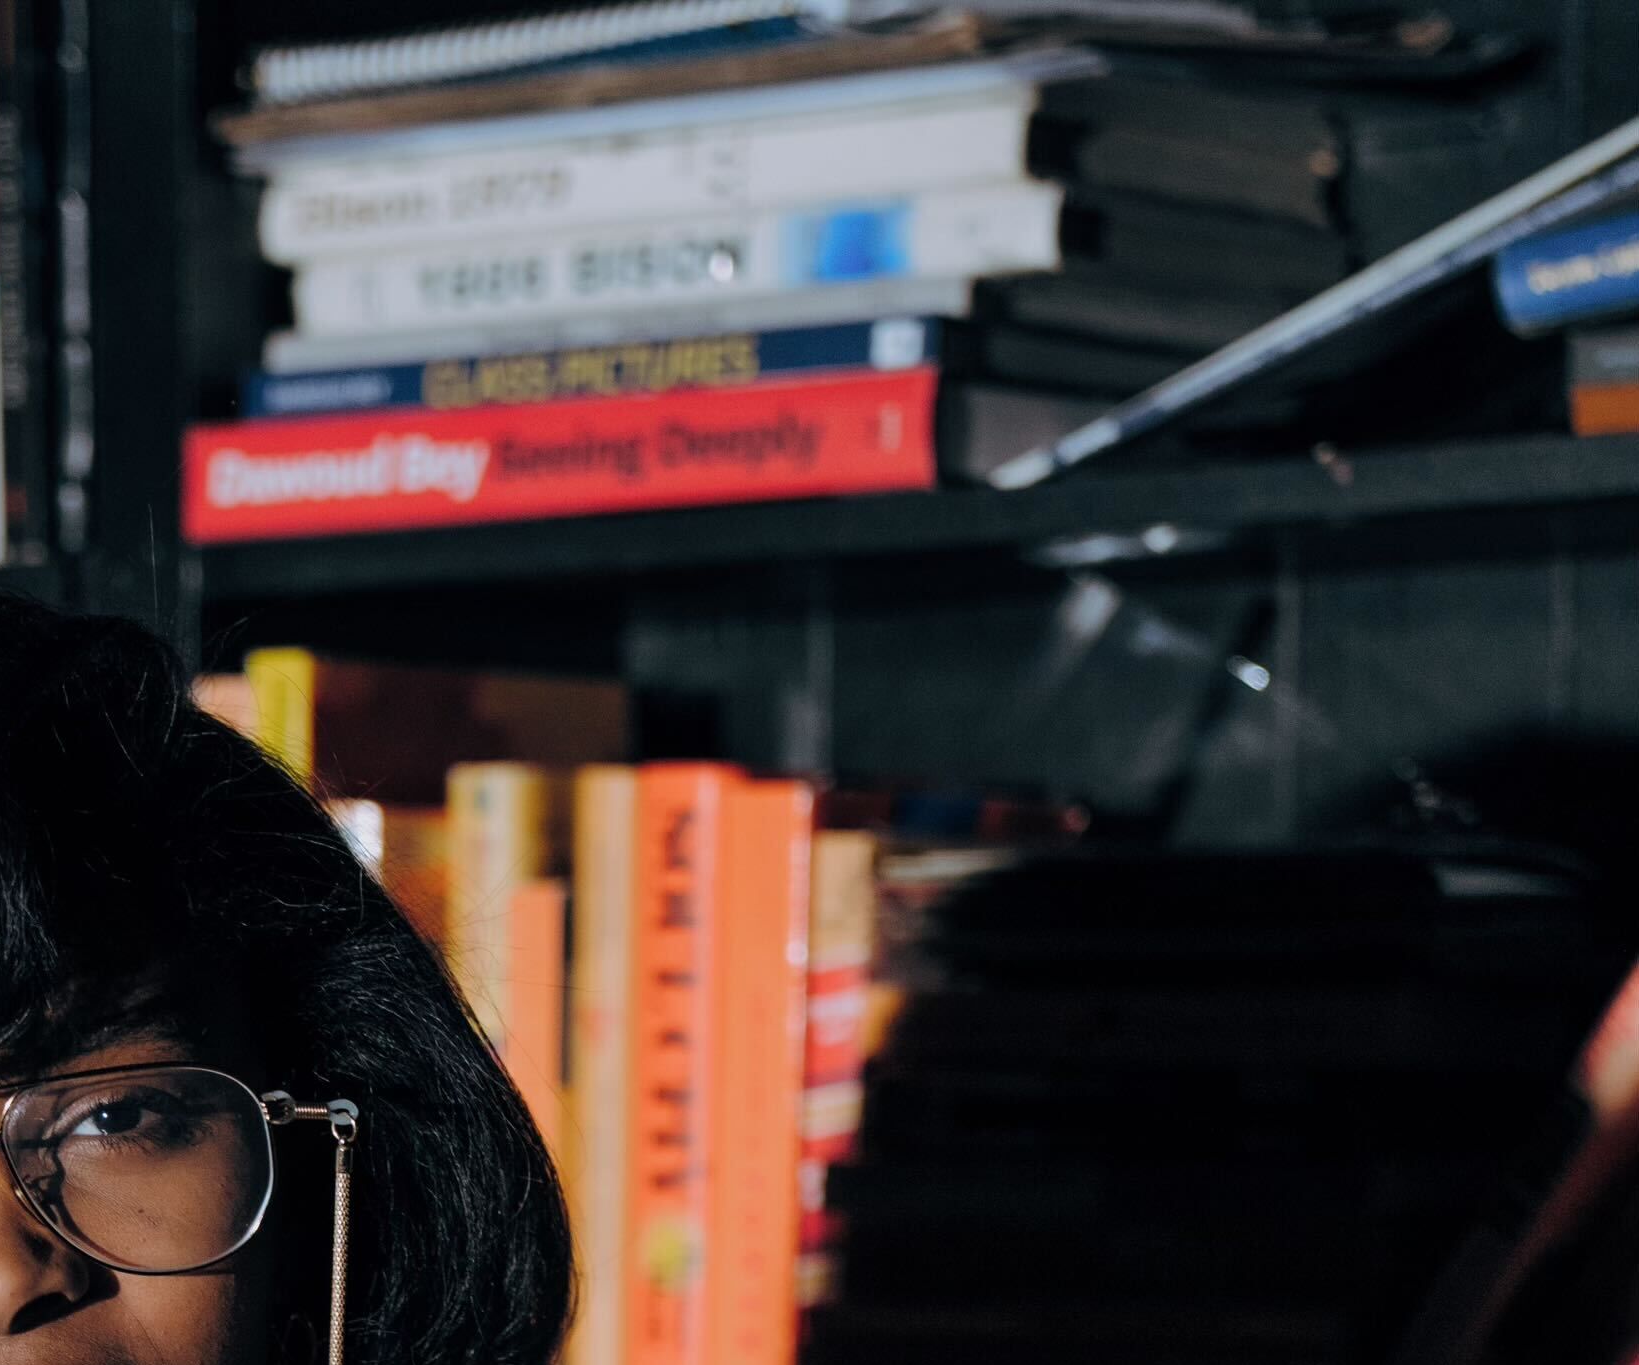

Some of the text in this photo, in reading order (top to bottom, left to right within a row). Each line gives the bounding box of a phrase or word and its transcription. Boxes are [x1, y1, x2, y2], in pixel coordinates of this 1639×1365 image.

[552, 332, 759, 398] PICTURES
[207, 414, 826, 507] Dawoud Bey Seeing Deeply
